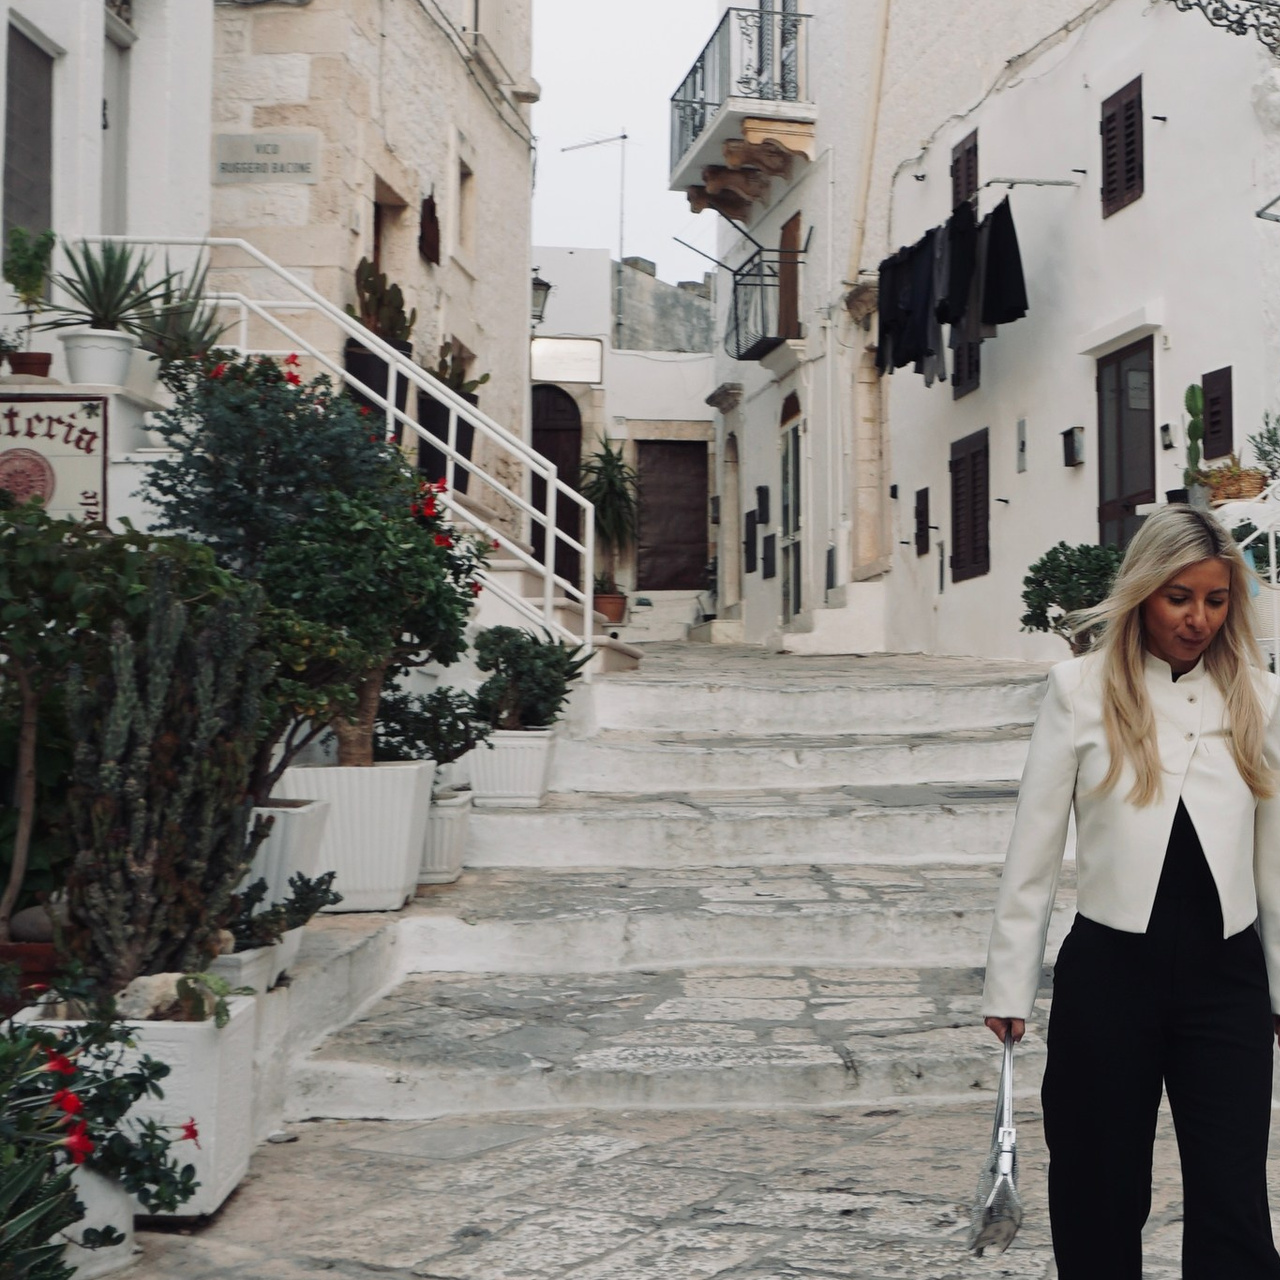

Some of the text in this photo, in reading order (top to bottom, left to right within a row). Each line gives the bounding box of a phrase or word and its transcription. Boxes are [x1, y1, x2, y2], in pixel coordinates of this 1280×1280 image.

[256, 144, 279, 154] VICO
[220, 162, 311, 173] RUGGERO BACONE
[0, 406, 99, 454] teria
